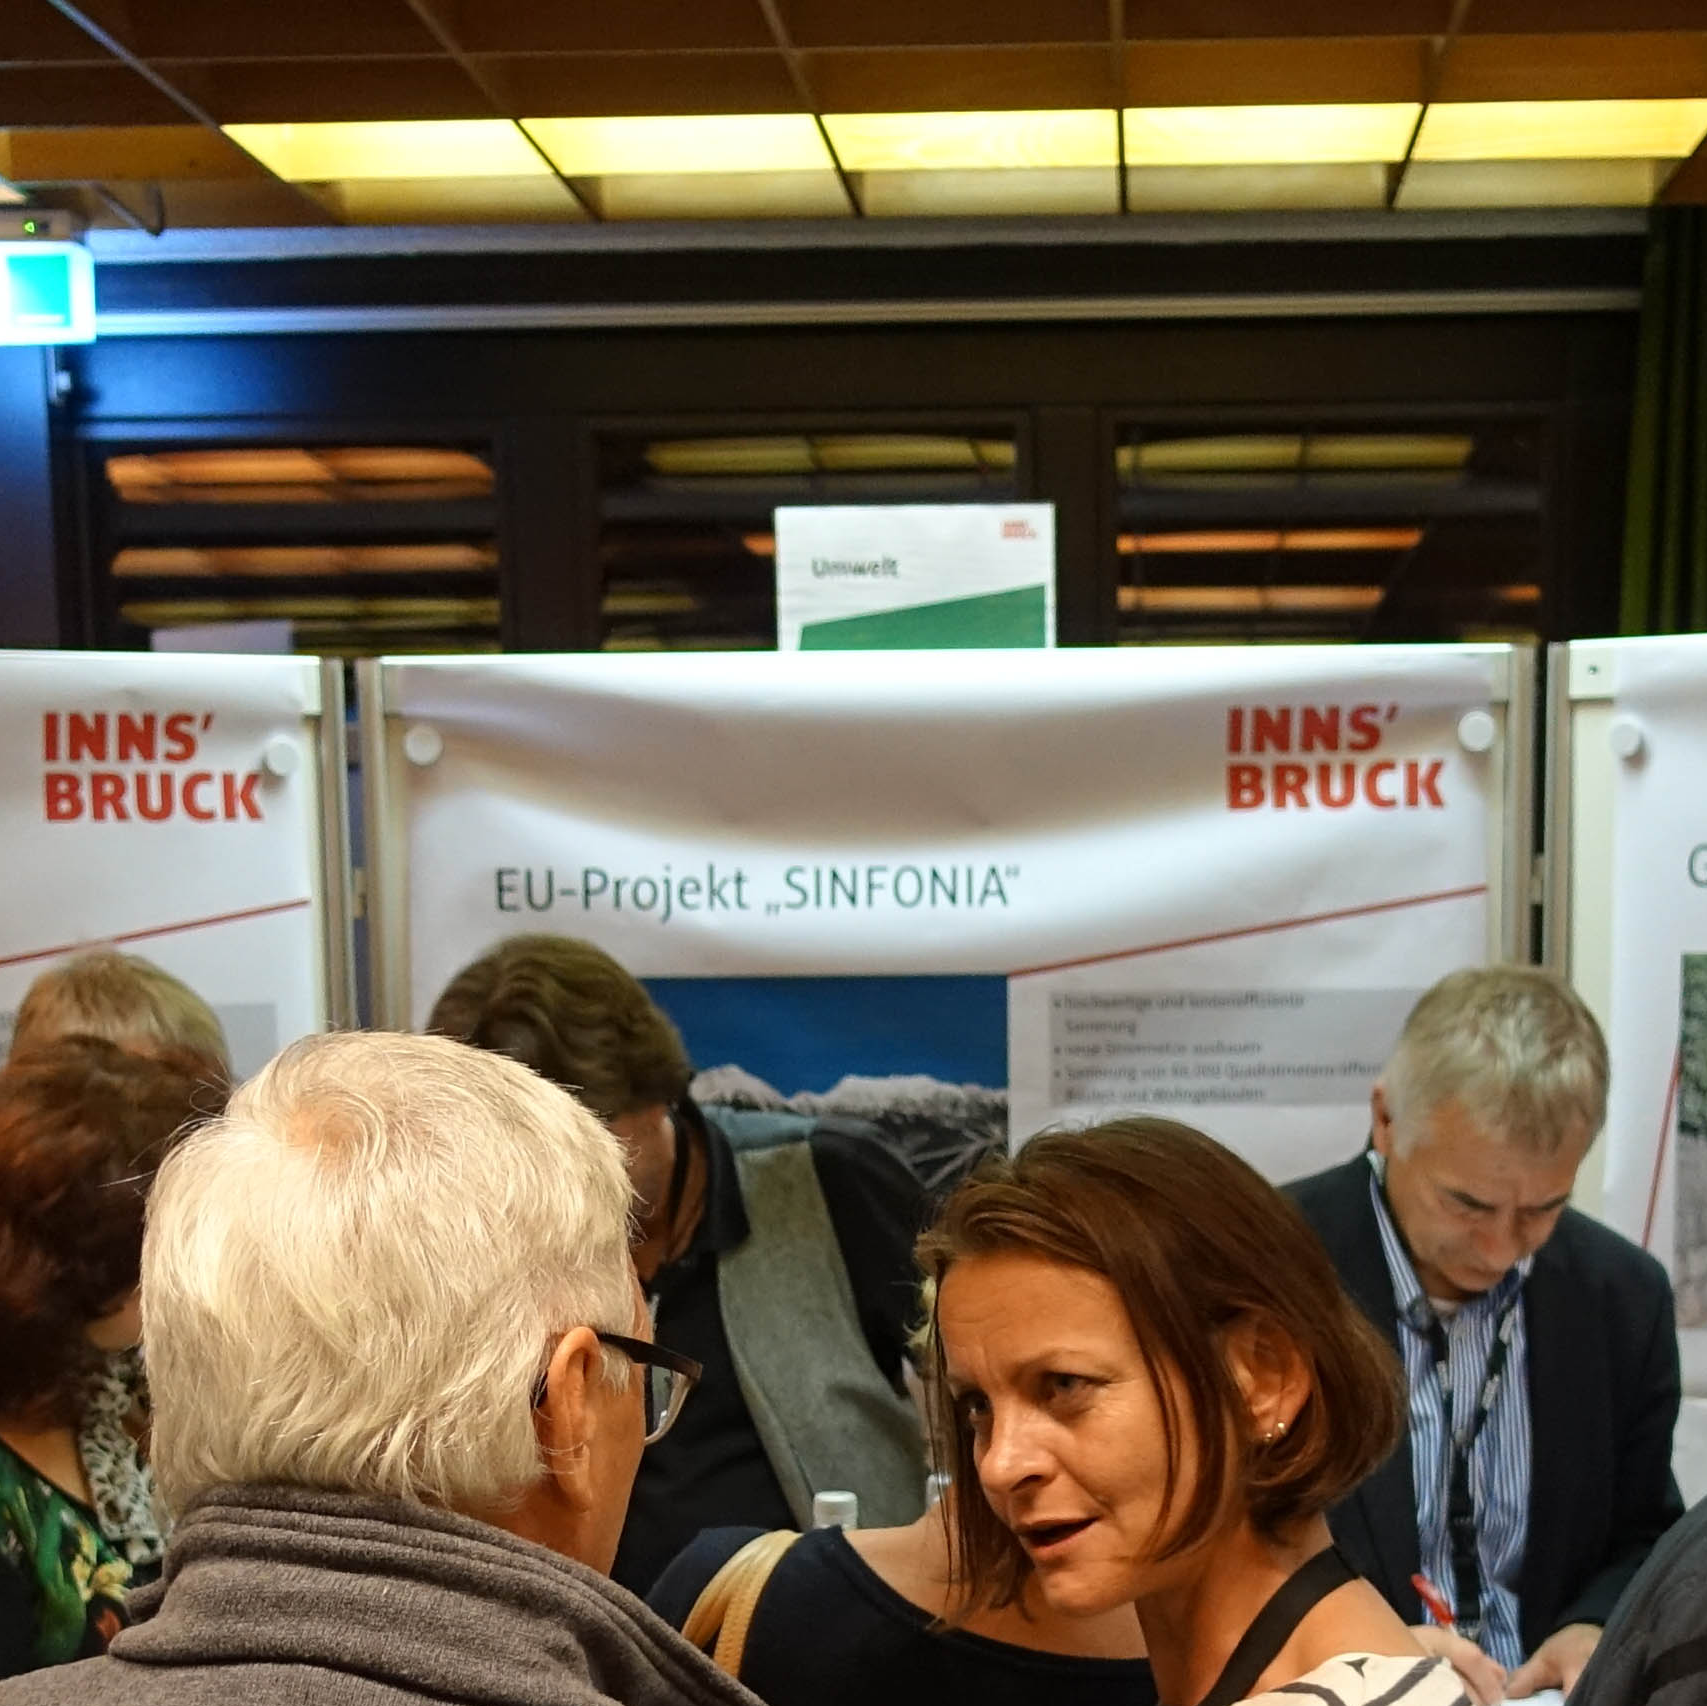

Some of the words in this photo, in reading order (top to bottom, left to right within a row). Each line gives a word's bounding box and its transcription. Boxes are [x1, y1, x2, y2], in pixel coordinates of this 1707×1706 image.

[811, 556, 899, 578] Umwelt
[44, 771, 264, 823] BRUCK
[1227, 760, 1446, 811] BRUCK
[495, 862, 747, 926] EU-Projekt
